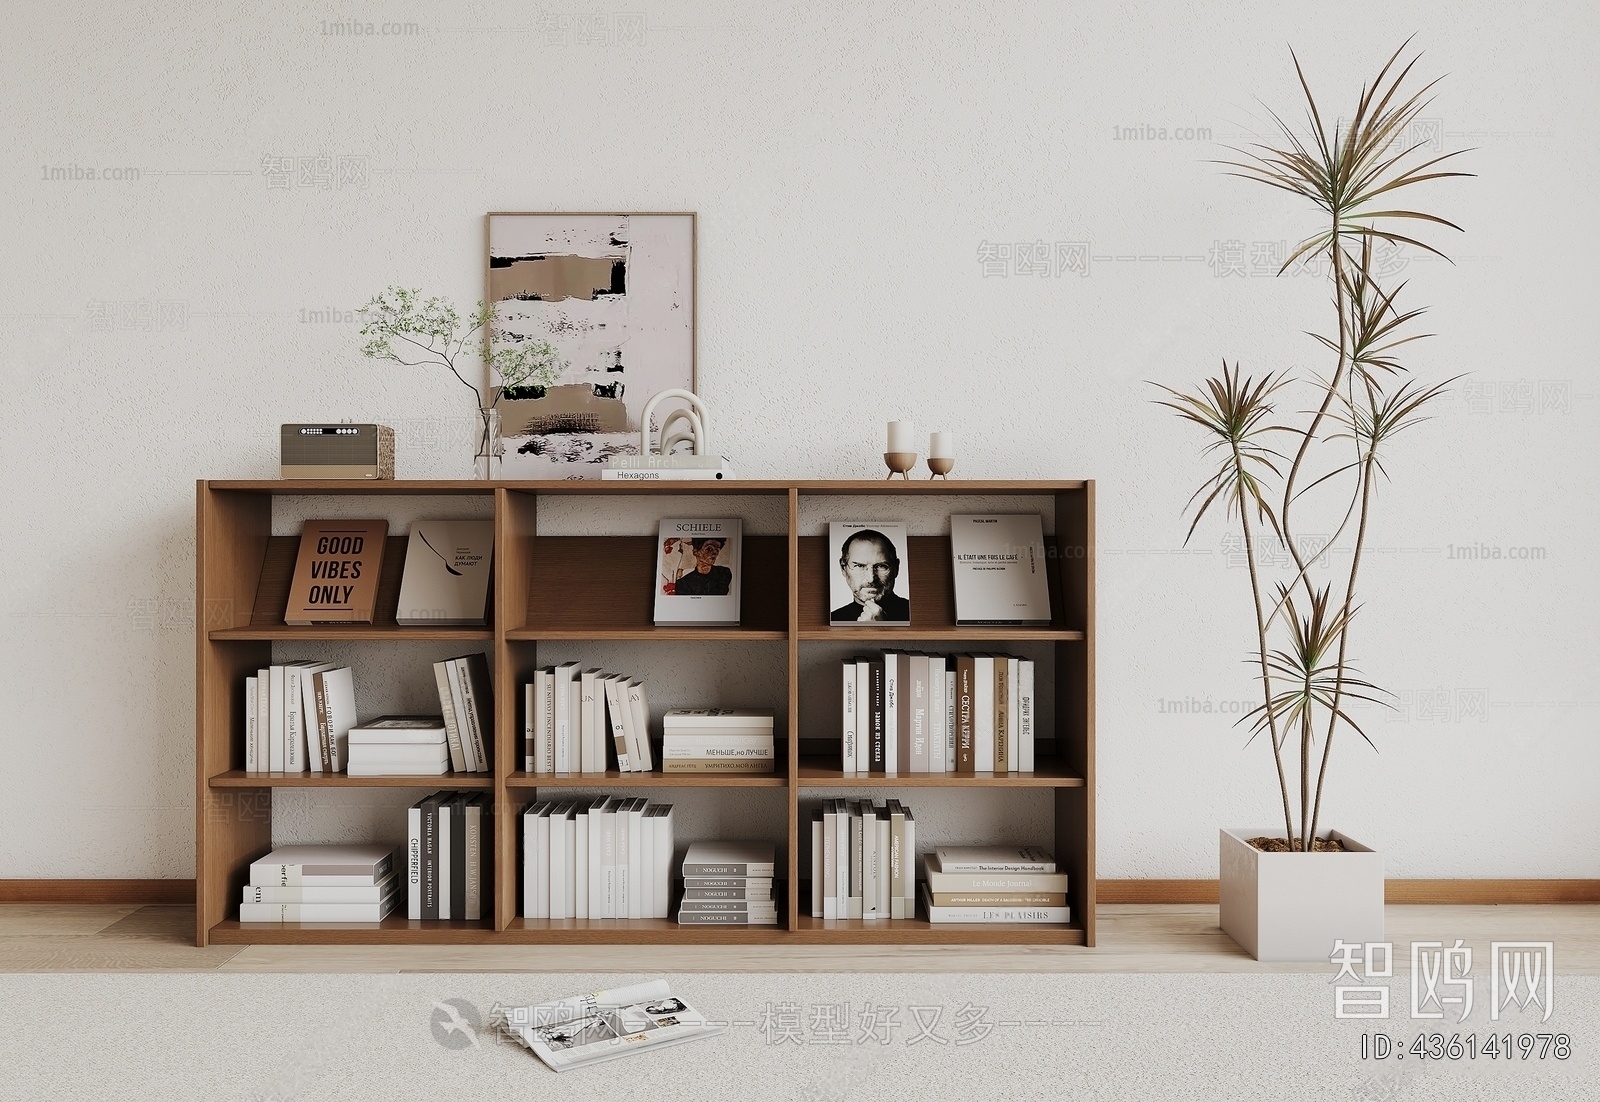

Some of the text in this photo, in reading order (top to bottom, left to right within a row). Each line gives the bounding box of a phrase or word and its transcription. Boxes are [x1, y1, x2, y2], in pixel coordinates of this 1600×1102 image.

[612, 456, 640, 468] Pelli
[617, 471, 660, 480] Hexagons
[676, 523, 722, 532] SCHIELE
[317, 536, 364, 555] GOOD
[1005, 553, 1019, 561] CAFÉ
[311, 560, 363, 579] VIBES
[308, 585, 355, 604] ONLY
[961, 695, 970, 724] СЕСТРА
[326, 706, 334, 733] ГОВОРИ
[287, 711, 297, 765] Братья Карамазовы
[914, 708, 925, 755] Мартин Иден
[469, 825, 477, 857] KONSTEN
[410, 838, 419, 884] CHIPPERFIELD
[1006, 880, 1032, 888] Journal
[983, 911, 1000, 919] LES
[1004, 911, 1049, 919] PLAISIRS
